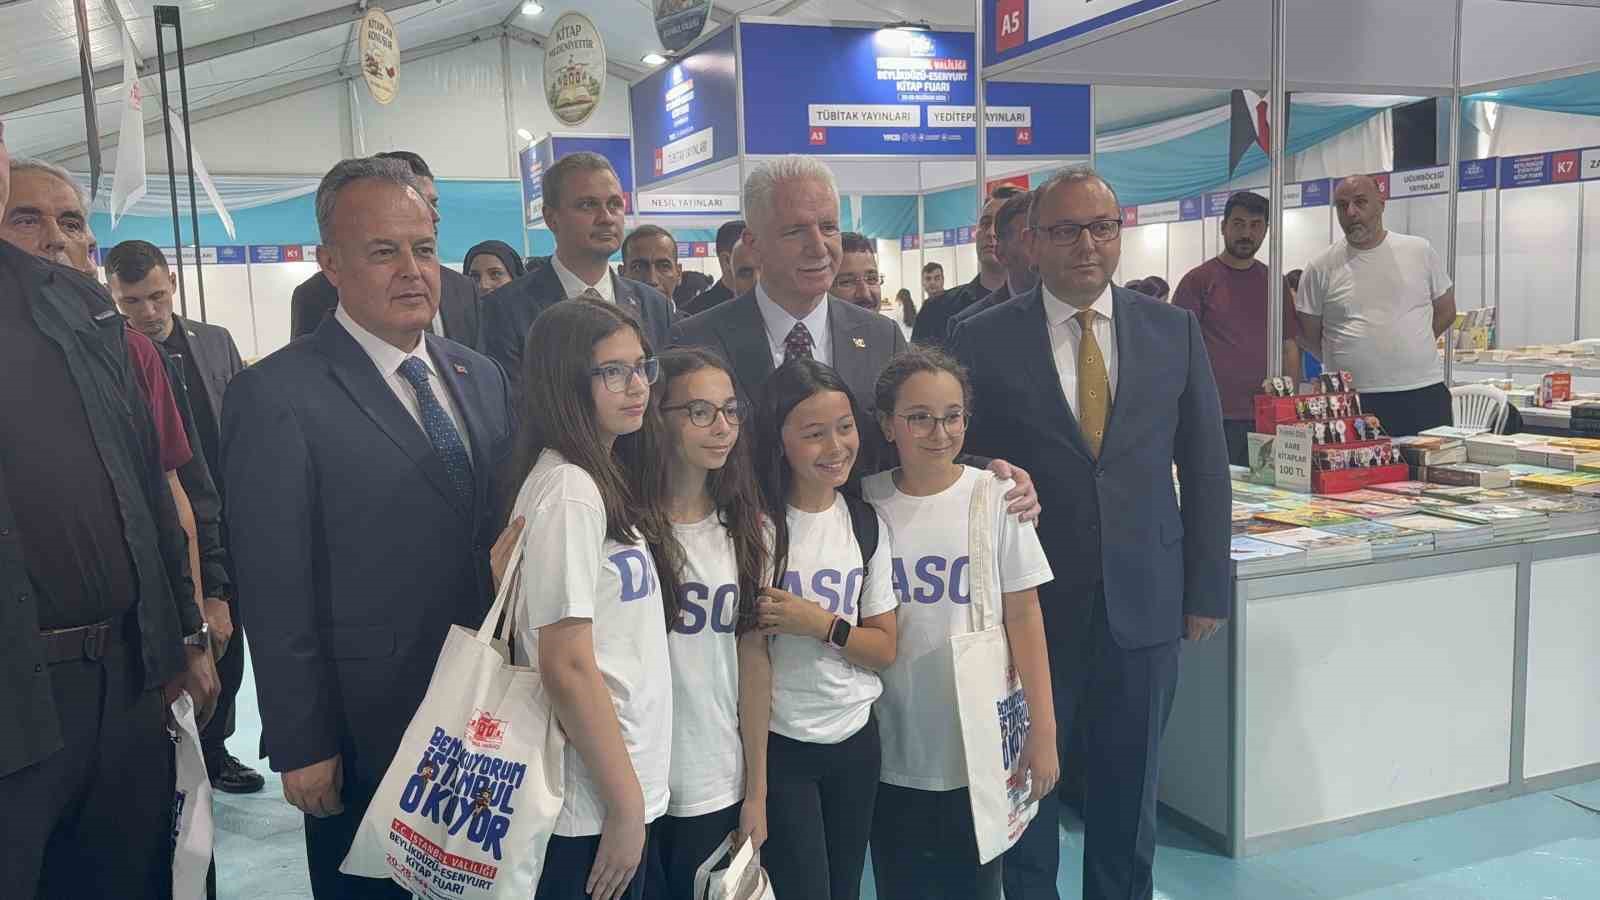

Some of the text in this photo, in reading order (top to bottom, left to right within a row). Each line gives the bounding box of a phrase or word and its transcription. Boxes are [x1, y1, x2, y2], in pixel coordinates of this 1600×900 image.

[1001, 11, 1020, 37] A5
[556, 24, 582, 42] KİTAP
[924, 81, 950, 91] FUARI
[816, 109, 911, 121] TÜBİTAK YAYINLARI
[934, 111, 1025, 122] YEDİTEPE AYINLARI
[1557, 161, 1574, 174] K7
[679, 199, 723, 208] YAYINLARI
[287, 248, 299, 258] K1
[1280, 465, 1306, 478] 100 TL
[608, 549, 655, 602] D
[430, 726, 527, 789] BEN KUYORUM
[409, 827, 449, 865] İSTANBL
[389, 831, 494, 890] BEYLİKDÜZÜ-ESENYURT
[406, 854, 431, 878] KİTAP
[433, 875, 465, 895] FUARI
